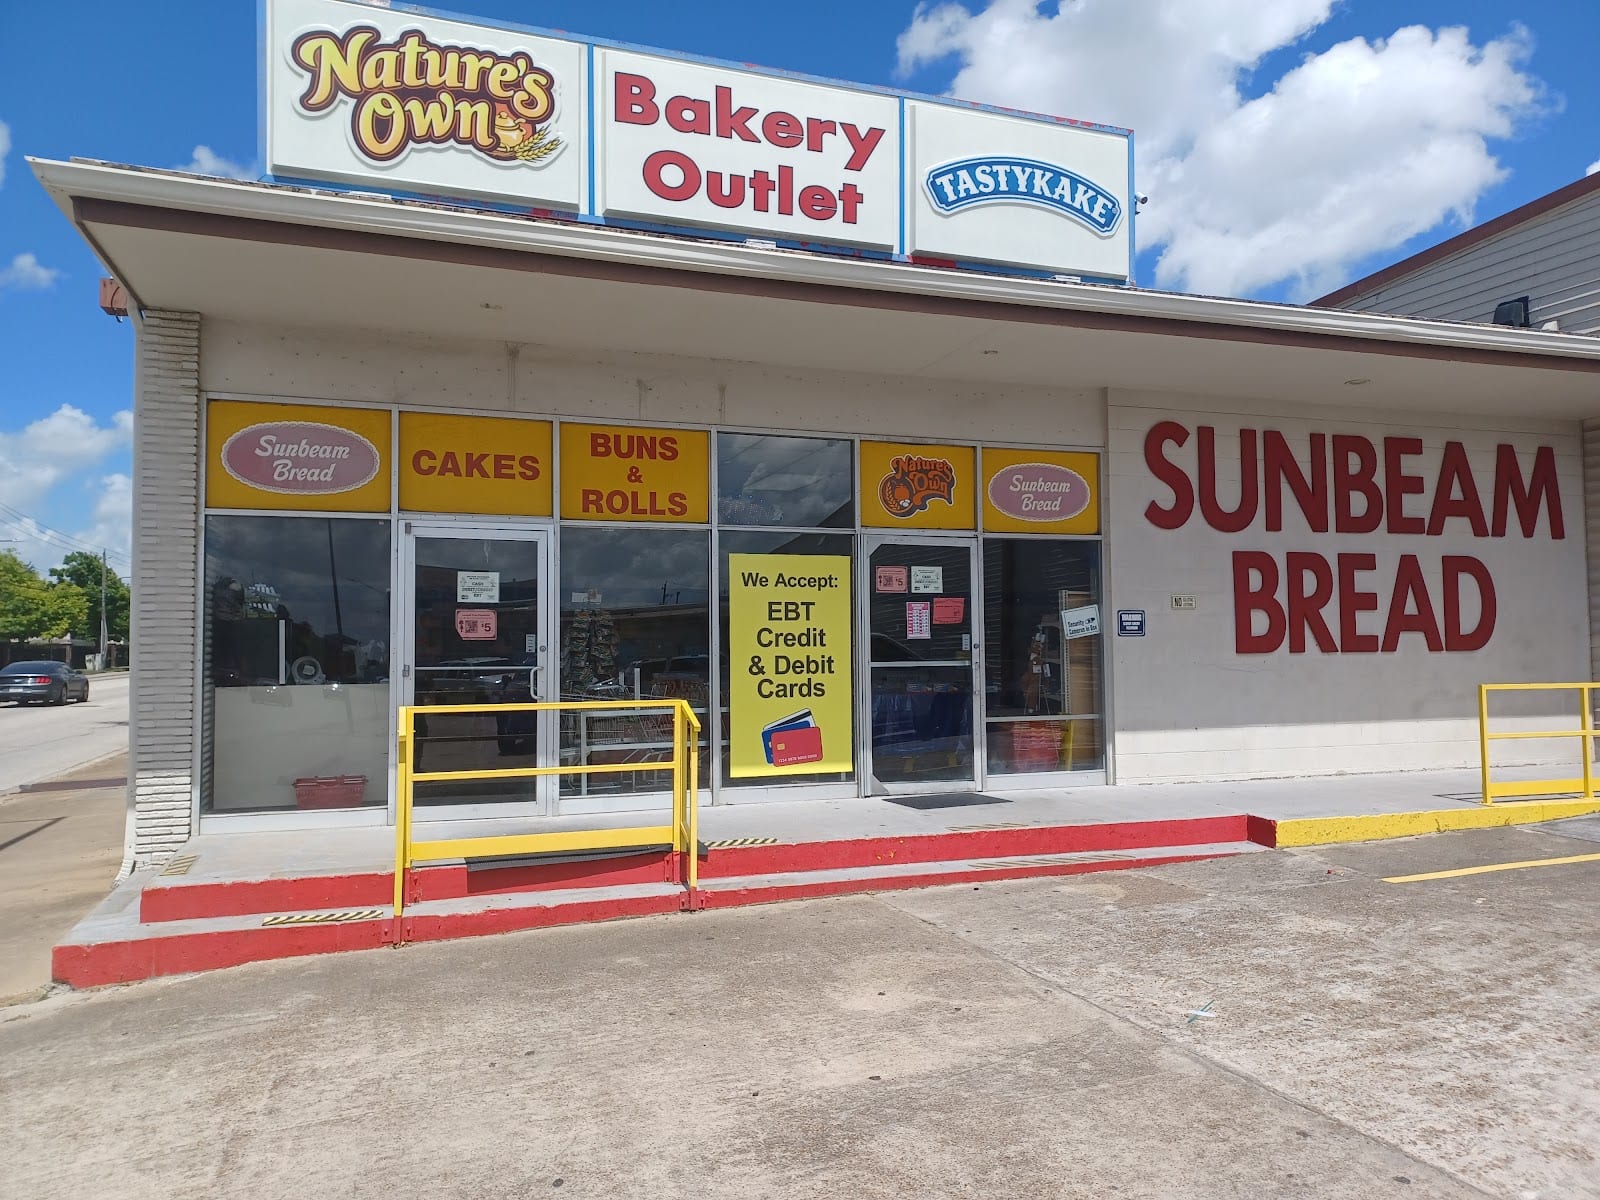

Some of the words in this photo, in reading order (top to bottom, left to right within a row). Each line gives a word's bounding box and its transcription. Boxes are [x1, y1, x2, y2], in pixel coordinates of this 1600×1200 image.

[296, 29, 551, 119] Nature's
[356, 91, 495, 155] Own
[614, 71, 886, 171] Bakery
[642, 150, 863, 224] Outlet
[934, 164, 1113, 224] TASTYKAKE
[254, 434, 350, 460] Sunbeam
[590, 433, 679, 461] BUNS
[272, 459, 337, 482] Bread
[412, 449, 541, 481] CAKES
[626, 465, 643, 484] &
[891, 457, 952, 480] Nature's
[911, 472, 948, 499] Own
[1009, 474, 1071, 493] Sunbeam
[1144, 421, 1566, 540] SUNBEAM
[582, 489, 688, 517] ROLLS
[1021, 494, 1061, 511] Bread
[741, 572, 769, 587] We
[774, 573, 838, 591] Accept:
[768, 601, 816, 621] EBT
[1232, 551, 1497, 654] BREAD
[757, 627, 826, 648] Credit
[748, 655, 766, 676] &
[774, 655, 835, 675] Debit
[757, 678, 826, 699] Cards
